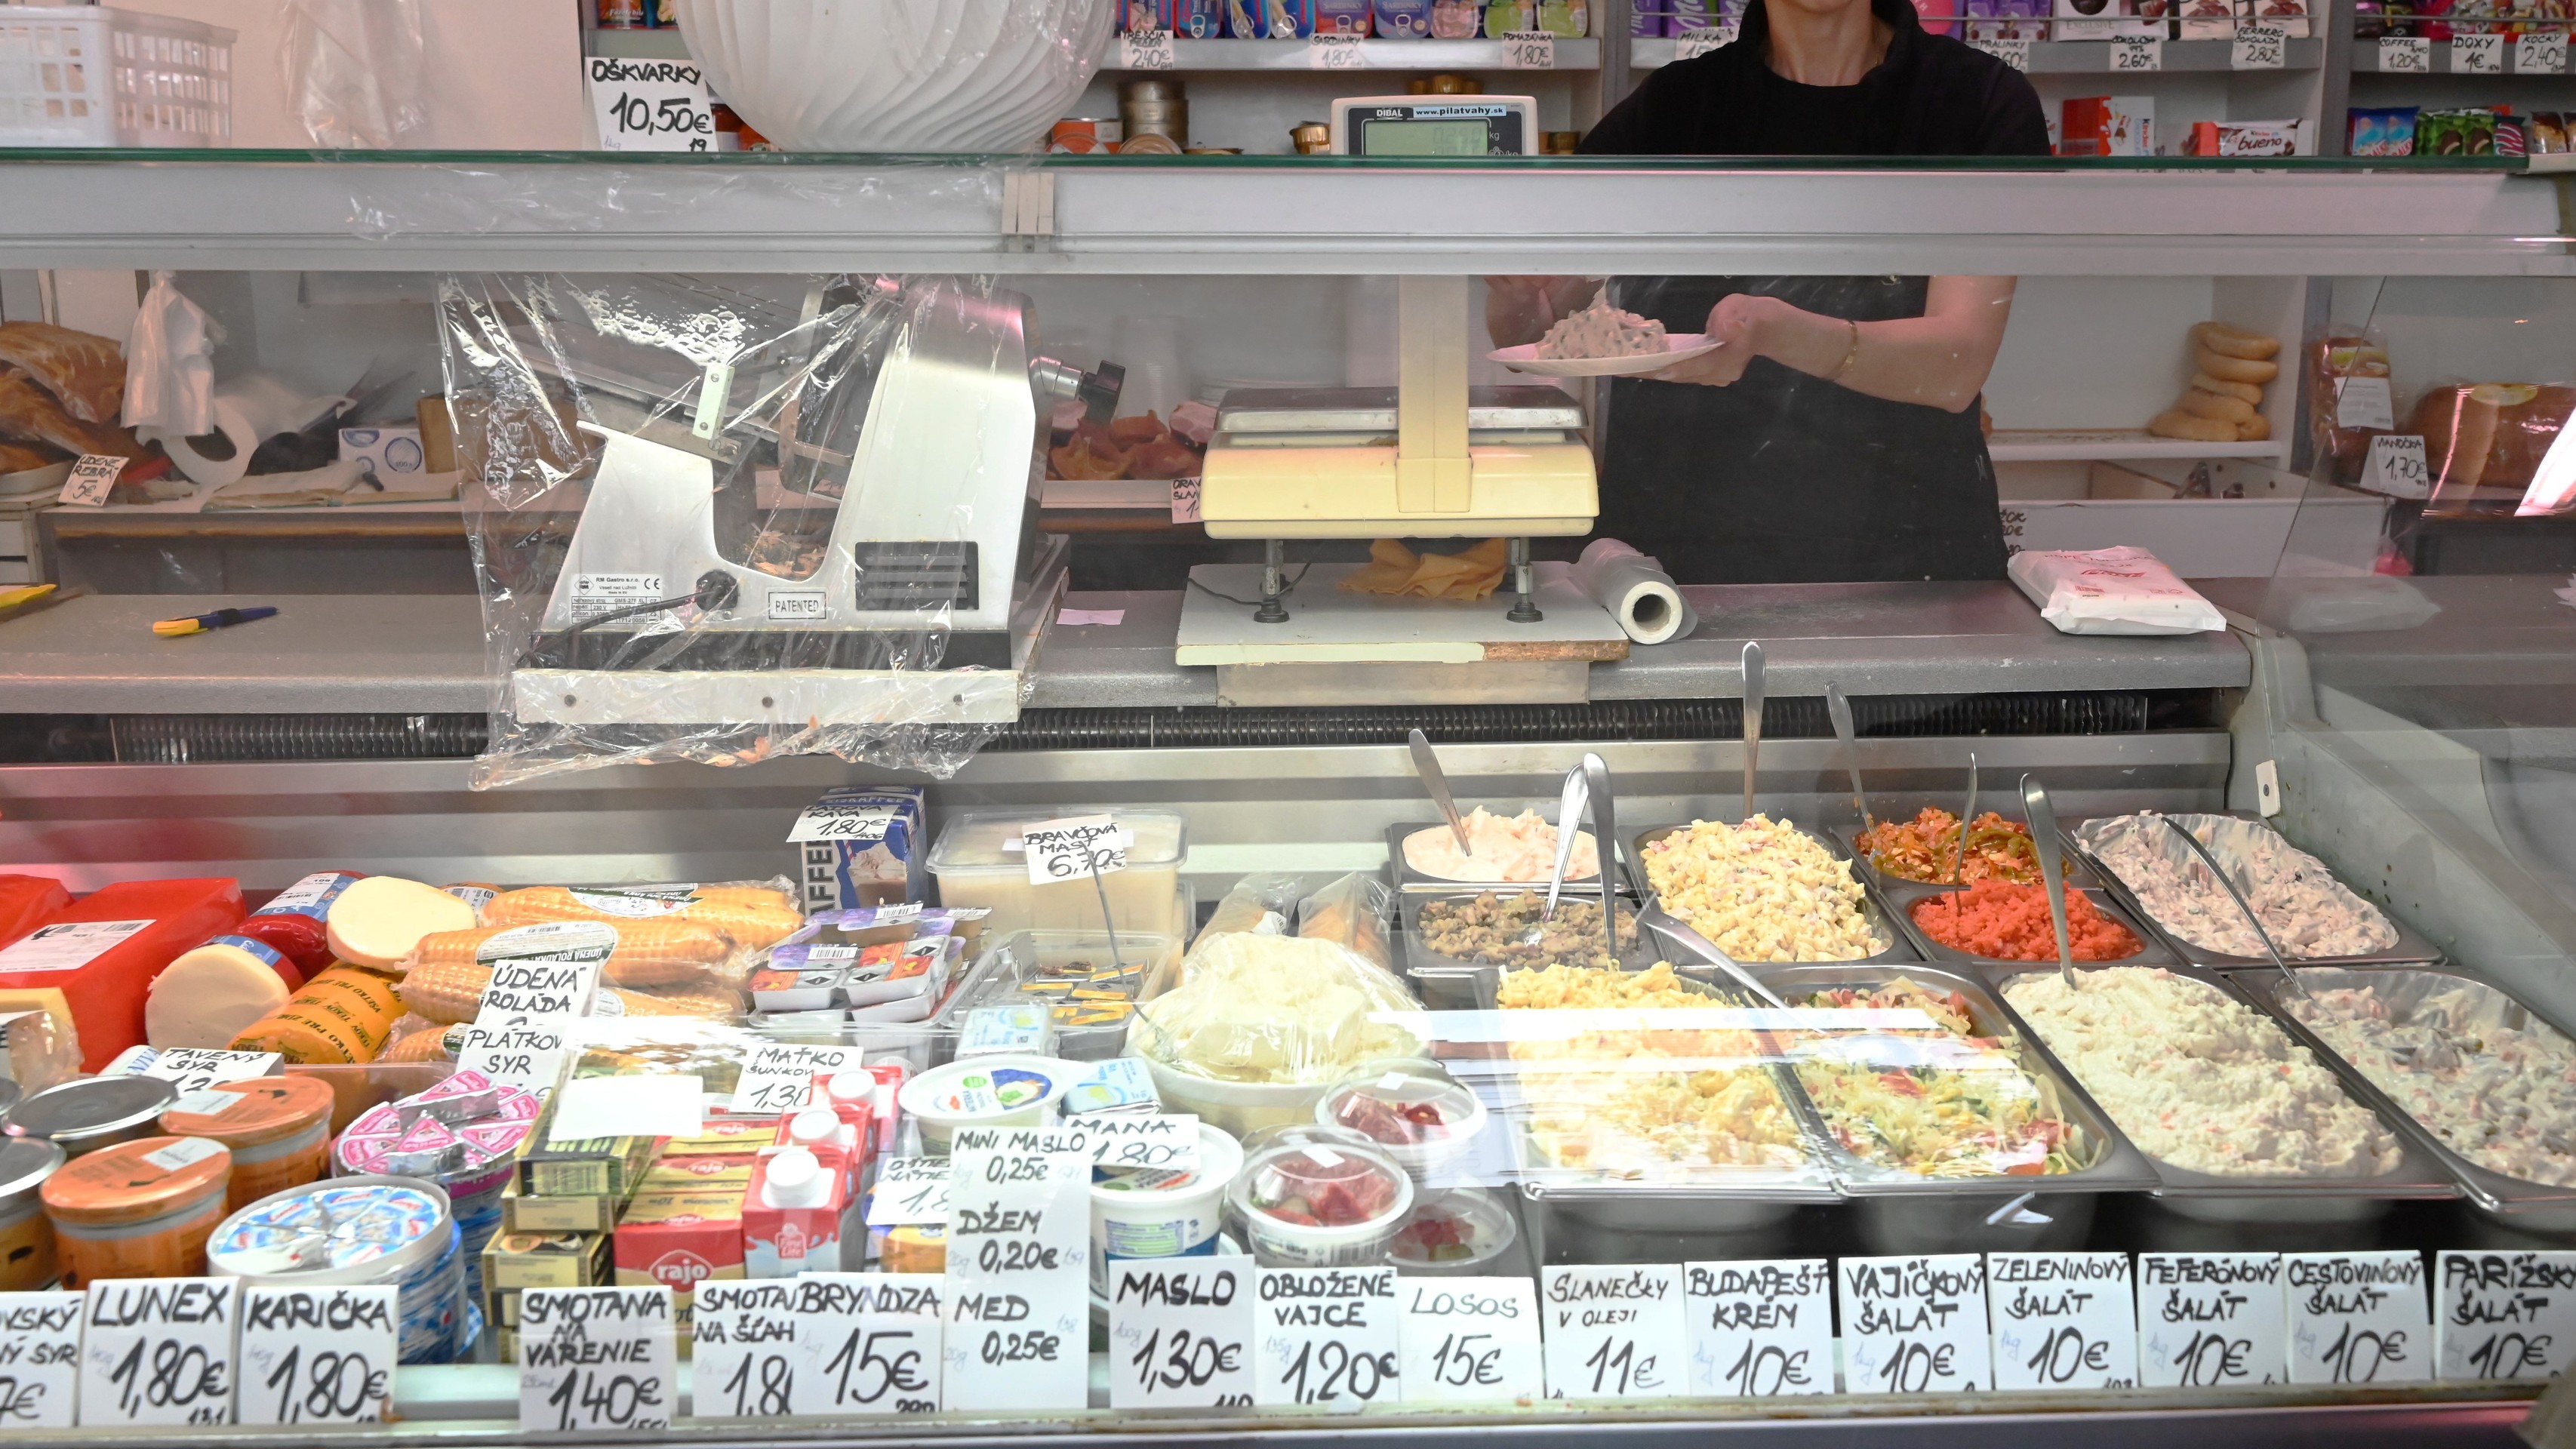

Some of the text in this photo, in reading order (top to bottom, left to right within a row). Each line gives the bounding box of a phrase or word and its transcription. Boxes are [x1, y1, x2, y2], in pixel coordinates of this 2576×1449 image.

[1680, 32, 1722, 43] MILKA
[1980, 40, 2025, 48] PRALINKY
[2238, 27, 2284, 37] FERRERO
[2379, 38, 2417, 47] COFFEE
[2453, 36, 2495, 48] DOXY
[1513, 44, 1549, 66] 1,80€
[2465, 52, 2485, 72] 1€
[2521, 45, 2566, 69] 2,40€
[592, 58, 700, 85] OŠKVARKY
[610, 91, 712, 136] 10,50€
[1377, 109, 1403, 117] DIBAL
[1416, 106, 1503, 116] www.pilatvahy.sk
[1489, 131, 1500, 140] kg
[2237, 136, 2282, 151] bueno
[2385, 455, 2427, 481] 1,70€
[72, 479, 98, 499] 5€
[775, 598, 819, 615] PATENTED
[817, 819, 887, 836] 1,80€
[1025, 822, 1118, 844] BRAVČOVÁ
[494, 964, 587, 993] ÚDENÁ
[167, 1060, 218, 1072] SYR
[482, 1054, 532, 1075] SYR
[758, 1046, 845, 1067] MAŤKO
[1070, 1119, 1177, 1134] MANA
[955, 1131, 1085, 1152] MINI MASLO
[688, 1162, 726, 1174] rajo
[986, 1156, 1048, 1185] 0,25€
[956, 1201, 1042, 1235] DŽEM
[657, 1258, 707, 1284] rajo
[979, 1239, 1058, 1274] 0,20€
[1992, 1254, 2129, 1282] ZELENINOVÝ
[1260, 1271, 1396, 1301] OBLOŽENÉ
[1547, 1269, 1670, 1303] SLANEČKY
[1688, 1263, 1831, 1297] BUDAPEŠŤ
[1846, 1259, 1985, 1299] VAJÍČKOVÝ
[2144, 1257, 2282, 1286] FEFERÓNOVÝ
[2288, 1257, 2421, 1286] CESTOVINOVÝ
[797, 1282, 942, 1317] BRYNDZA
[1116, 1269, 1236, 1307] MASLO
[1410, 1286, 1519, 1319] LOSOS
[2005, 1286, 2093, 1319] ŠALÁT
[2304, 1284, 2389, 1315] ŠALÁT
[91, 1283, 229, 1326] LUNEX
[246, 1290, 393, 1334] KARIČKA
[520, 1291, 666, 1324] SMOTANA
[954, 1292, 1030, 1322] MED
[1275, 1302, 1367, 1327] VAJCE
[1581, 1309, 1637, 1327] OLEJI
[1713, 1296, 1798, 1330] KRÉM
[1854, 1297, 1959, 1335] ŠALÁT
[2162, 1289, 2248, 1322] ŠALÁT
[2450, 1287, 2549, 1327] ŠALÁT
[550, 1321, 587, 1343] NA
[694, 1321, 726, 1343] NA
[27, 1343, 78, 1367] SYR
[982, 1330, 1060, 1367] 0,25€
[1133, 1328, 1242, 1394] 1,30€
[1433, 1332, 1504, 1386] 15€
[2027, 1326, 2110, 1384] 10€
[2174, 1329, 2252, 1387] 10€
[2321, 1321, 2407, 1383] 10€
[2469, 1332, 2553, 1380] 10€
[111, 1335, 230, 1420] 1,80€
[824, 1326, 929, 1405] 15€
[1281, 1340, 1400, 1404] 1,20€
[1585, 1335, 1665, 1395] 11€
[1725, 1337, 1812, 1396] 10€
[1879, 1338, 1956, 1394] 10€
[266, 1343, 389, 1424] 1,80€
[548, 1367, 663, 1431] 1,40€
